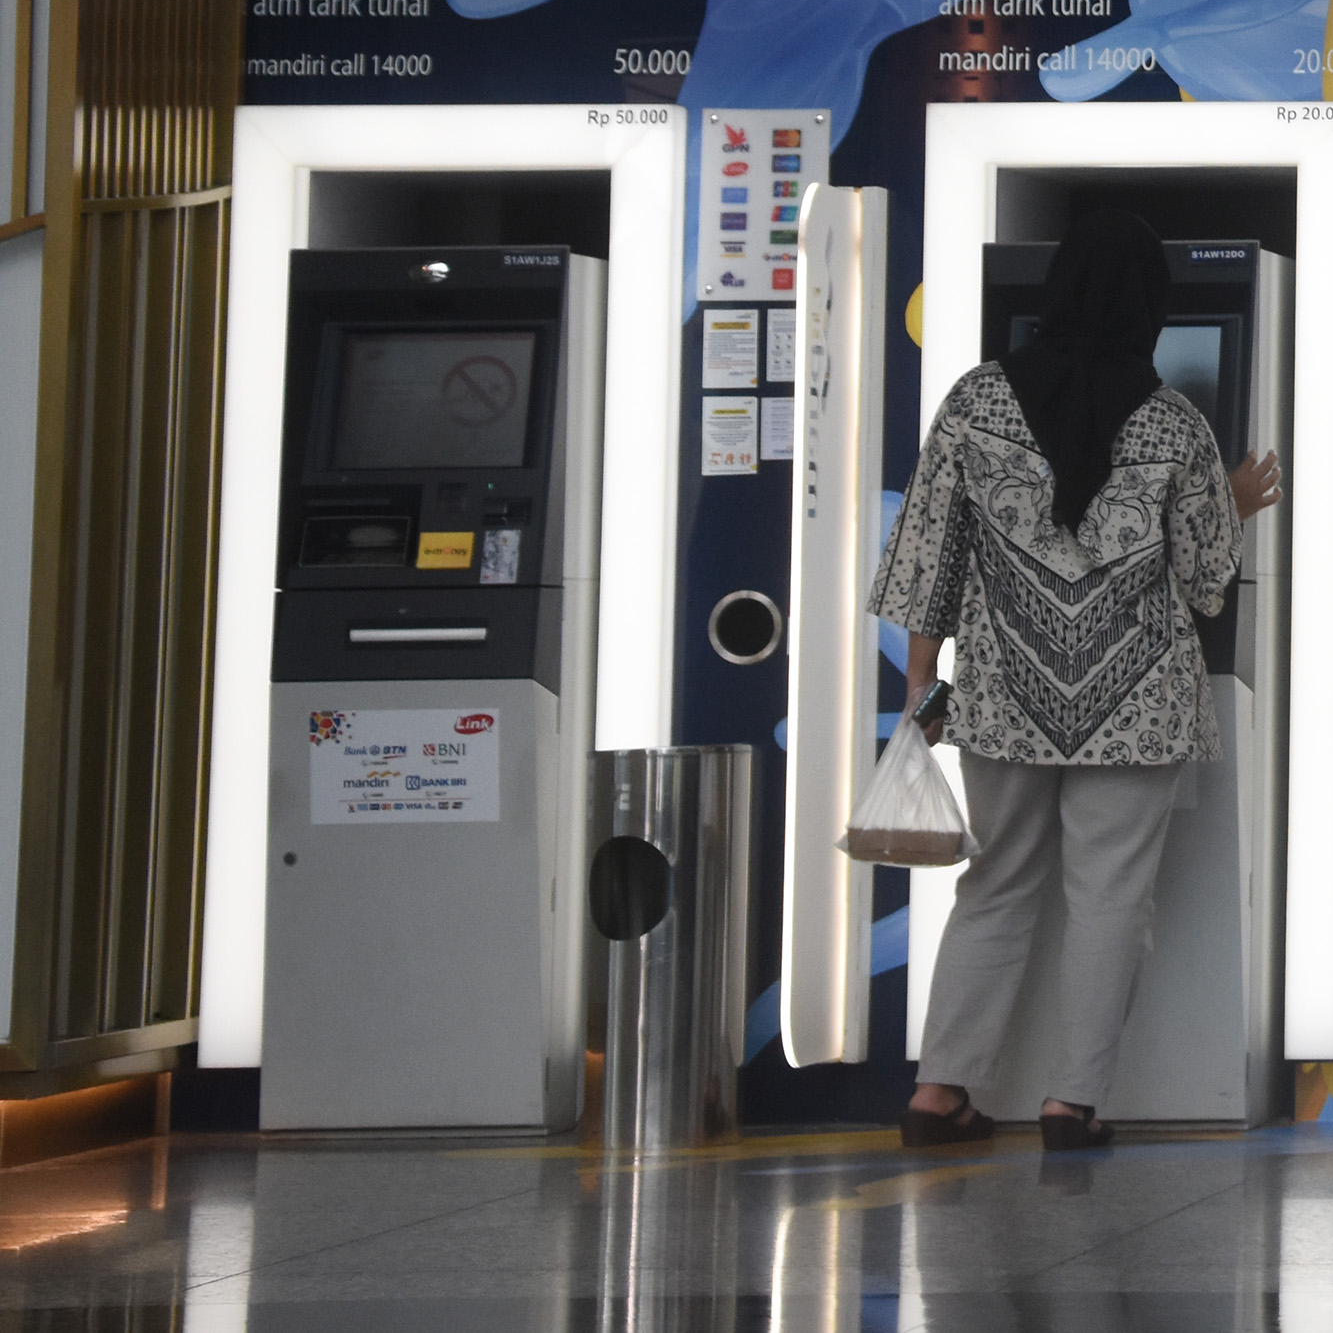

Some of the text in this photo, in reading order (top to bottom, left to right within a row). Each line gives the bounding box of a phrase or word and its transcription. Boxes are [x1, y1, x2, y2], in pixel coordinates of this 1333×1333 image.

[248, 53, 432, 76] mandiri call 14000
[614, 49, 690, 75] 50.000
[939, 45, 1156, 72] mandiri call 14000
[587, 109, 668, 127] Rp 50.000
[1277, 106, 1297, 124] Rp
[455, 714, 493, 734] Link
[344, 745, 407, 756] Bank BTN
[438, 743, 467, 757] BNI
[343, 776, 389, 788] mandiri
[421, 777, 467, 787] BANK BRI
[405, 802, 422, 810] VISA
